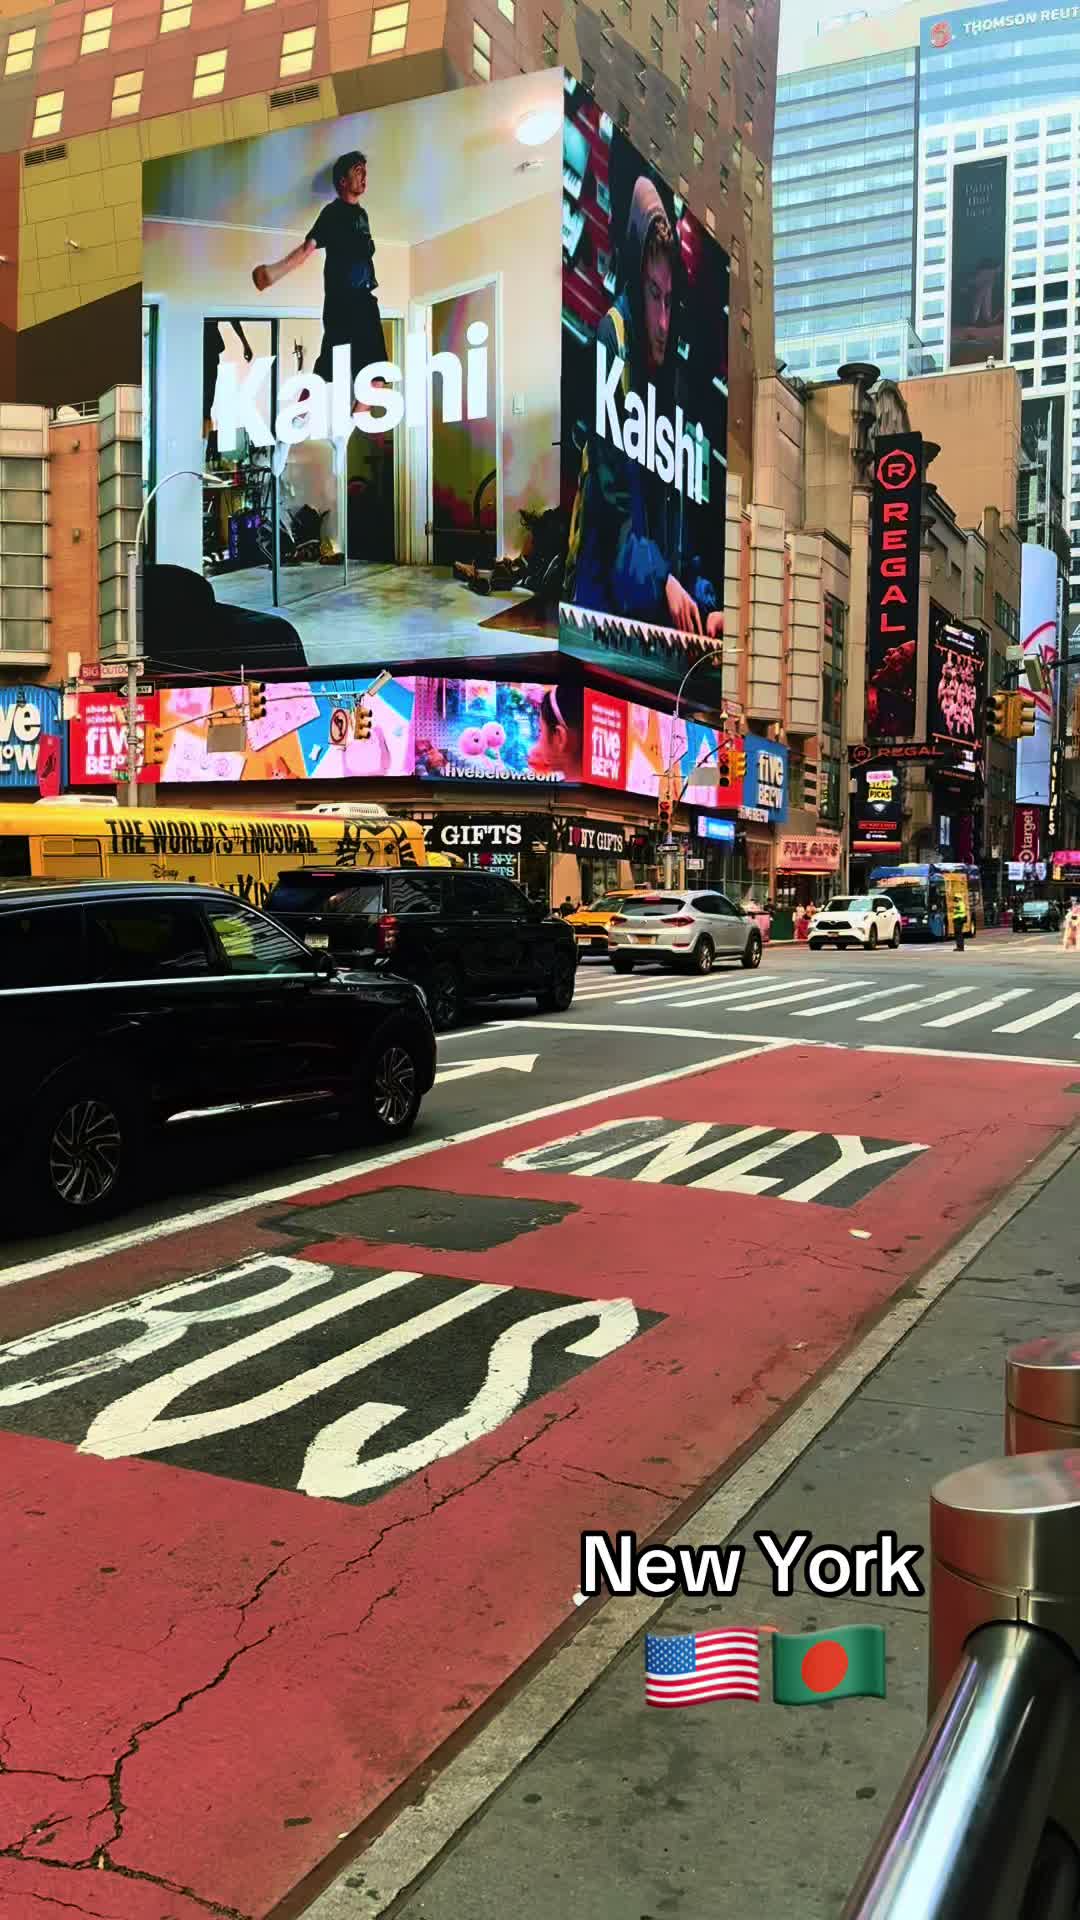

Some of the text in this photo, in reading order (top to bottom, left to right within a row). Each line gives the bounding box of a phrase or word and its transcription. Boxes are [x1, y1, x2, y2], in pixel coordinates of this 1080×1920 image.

[962, 12, 1038, 34] THOMSON
[215, 320, 490, 453] Kalshi
[595, 339, 704, 506] Kalshi
[880, 502, 910, 633] REGAL
[105, 819, 146, 854] THE
[149, 820, 233, 854] WORLD'S
[440, 824, 522, 845] GIFTS
[597, 831, 624, 853] GIFTS
[1022, 809, 1036, 849] target
[502, 1116, 932, 1202] ONLY
[0, 1252, 640, 1499] BUS
